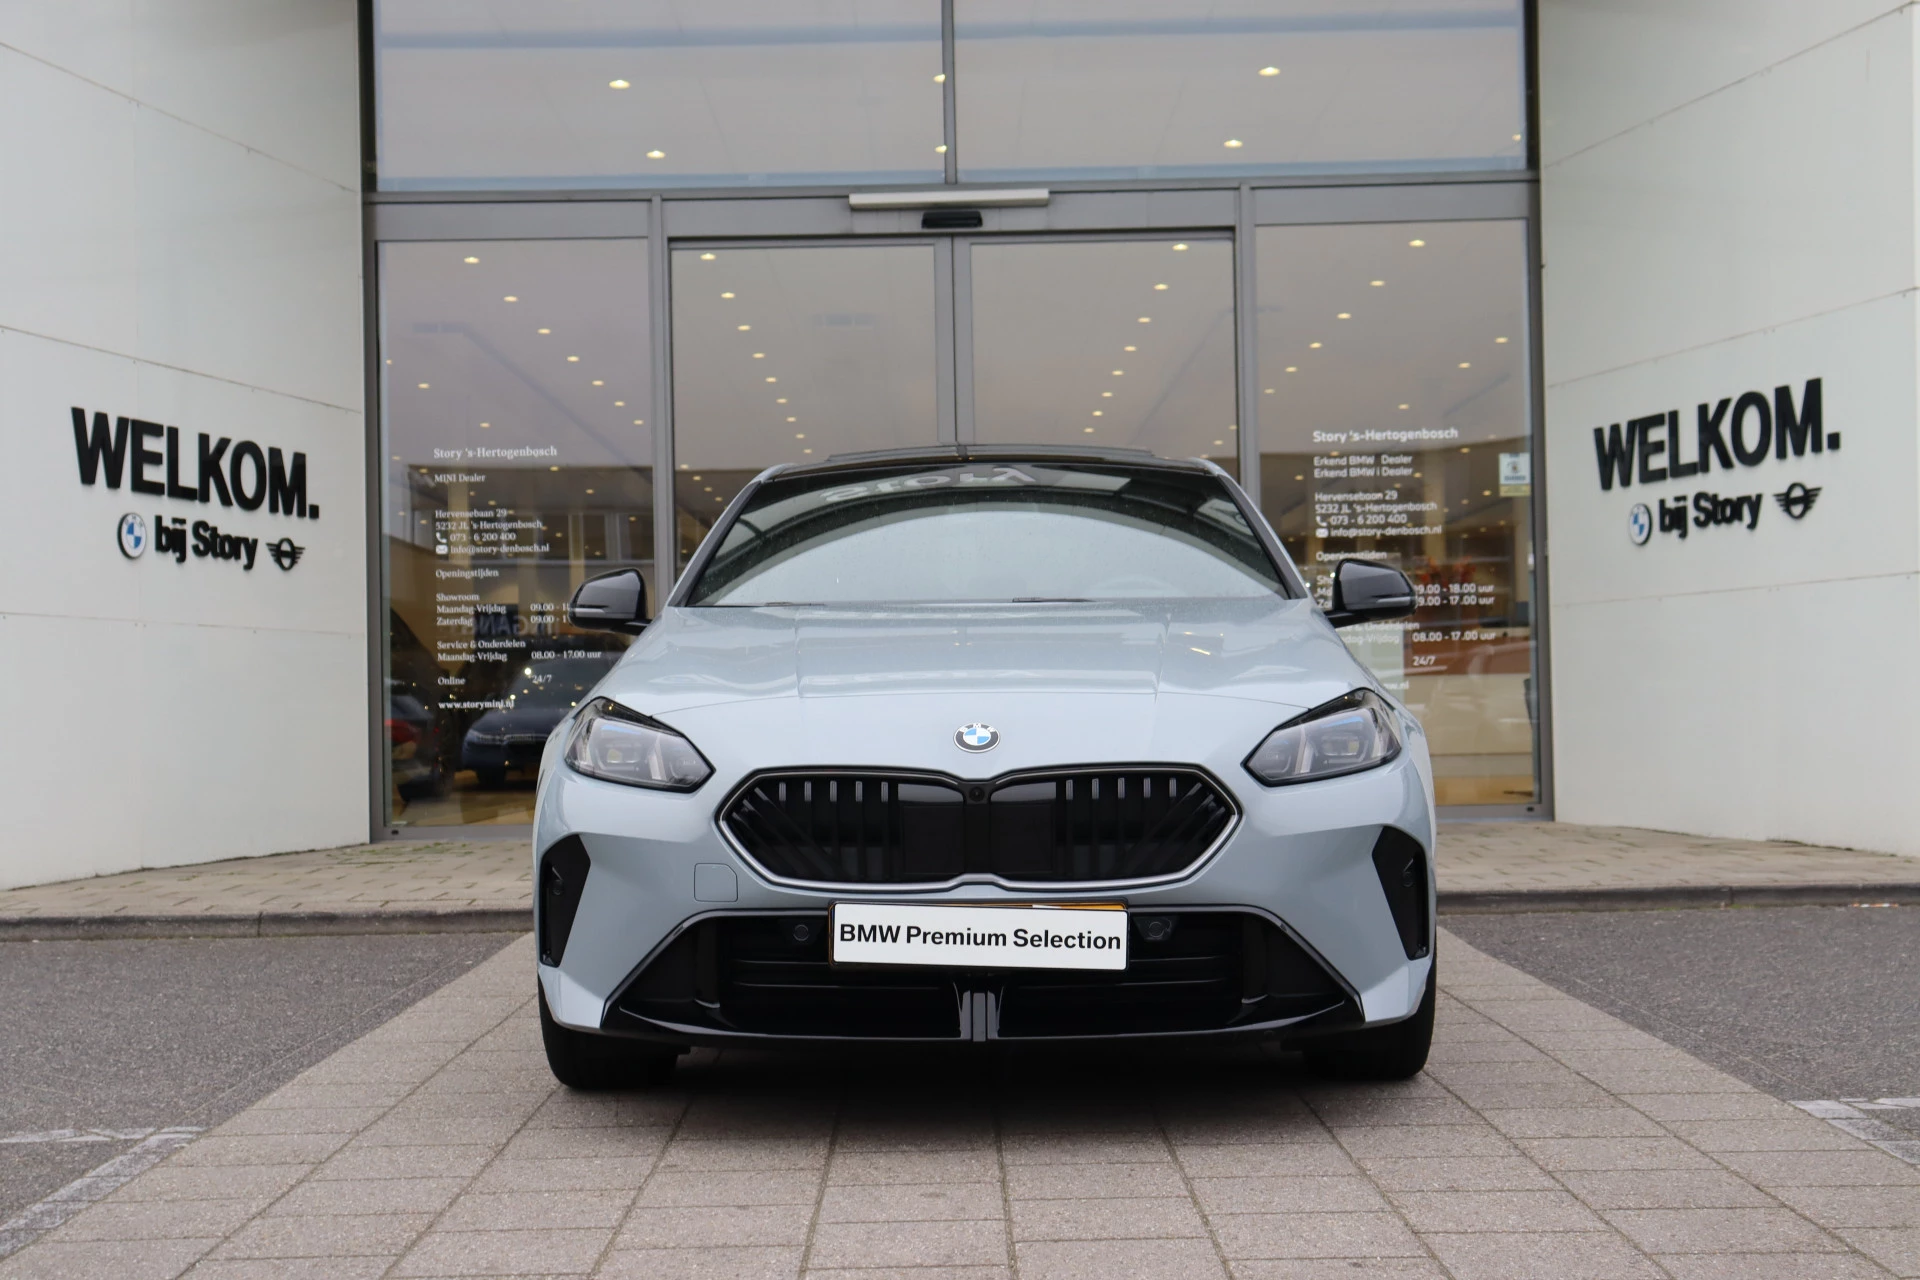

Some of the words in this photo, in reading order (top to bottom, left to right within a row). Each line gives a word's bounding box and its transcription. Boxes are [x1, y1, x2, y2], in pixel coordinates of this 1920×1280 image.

[1313, 431, 1347, 443] Story
[1594, 377, 1840, 491] WELKOM.
[434, 448, 462, 460] Story
[71, 407, 319, 519] WELKOM.
[1314, 455, 1347, 466] Erkend
[1349, 455, 1375, 466] BMW
[1381, 454, 1413, 464] Dealer
[1314, 467, 1347, 478] Erkend
[1349, 466, 1375, 477] BMW
[1382, 466, 1413, 477] Dealer
[434, 474, 456, 483] MINI
[459, 474, 486, 482] Dealer
[1385, 490, 1398, 500] 29
[496, 508, 507, 517] 29
[1315, 504, 1338, 513] 5232
[1330, 515, 1348, 525] 073
[1357, 515, 1364, 524] 6
[1366, 514, 1385, 524] 200
[1387, 514, 1407, 523] 400
[1659, 495, 1687, 539] bij
[1694, 492, 1763, 530] Story
[435, 521, 456, 530] 5232
[450, 533, 466, 541] 073
[473, 533, 480, 541] 6
[482, 532, 498, 541] 200
[500, 532, 516, 540] 400
[1331, 525, 1442, 539] info@story-denbosch.nl
[155, 515, 187, 563] bij
[192, 521, 258, 570] Story
[450, 543, 549, 555] info@story-denbosch.nl
[436, 569, 499, 579] Openingstijden
[436, 593, 480, 602] Showroom
[1416, 595, 1441, 606] 9.00
[1478, 597, 1495, 605] uur
[530, 603, 554, 611] 09.00
[437, 616, 474, 627] Zaterdag
[530, 615, 554, 624] 09.00
[1412, 632, 1442, 642] 08.00
[1480, 632, 1496, 640] uur
[437, 640, 468, 649] Service
[478, 639, 526, 648] Onderdelen
[531, 651, 555, 659] 08.00
[563, 650, 585, 658] 17.00
[1413, 655, 1436, 666] 24/7
[437, 676, 466, 685] Online
[531, 674, 552, 684] 24/7
[438, 700, 515, 710] www.storymini.nl
[840, 923, 901, 943] BMW
[906, 925, 1007, 946] Premium
[1013, 928, 1121, 950] Selection
